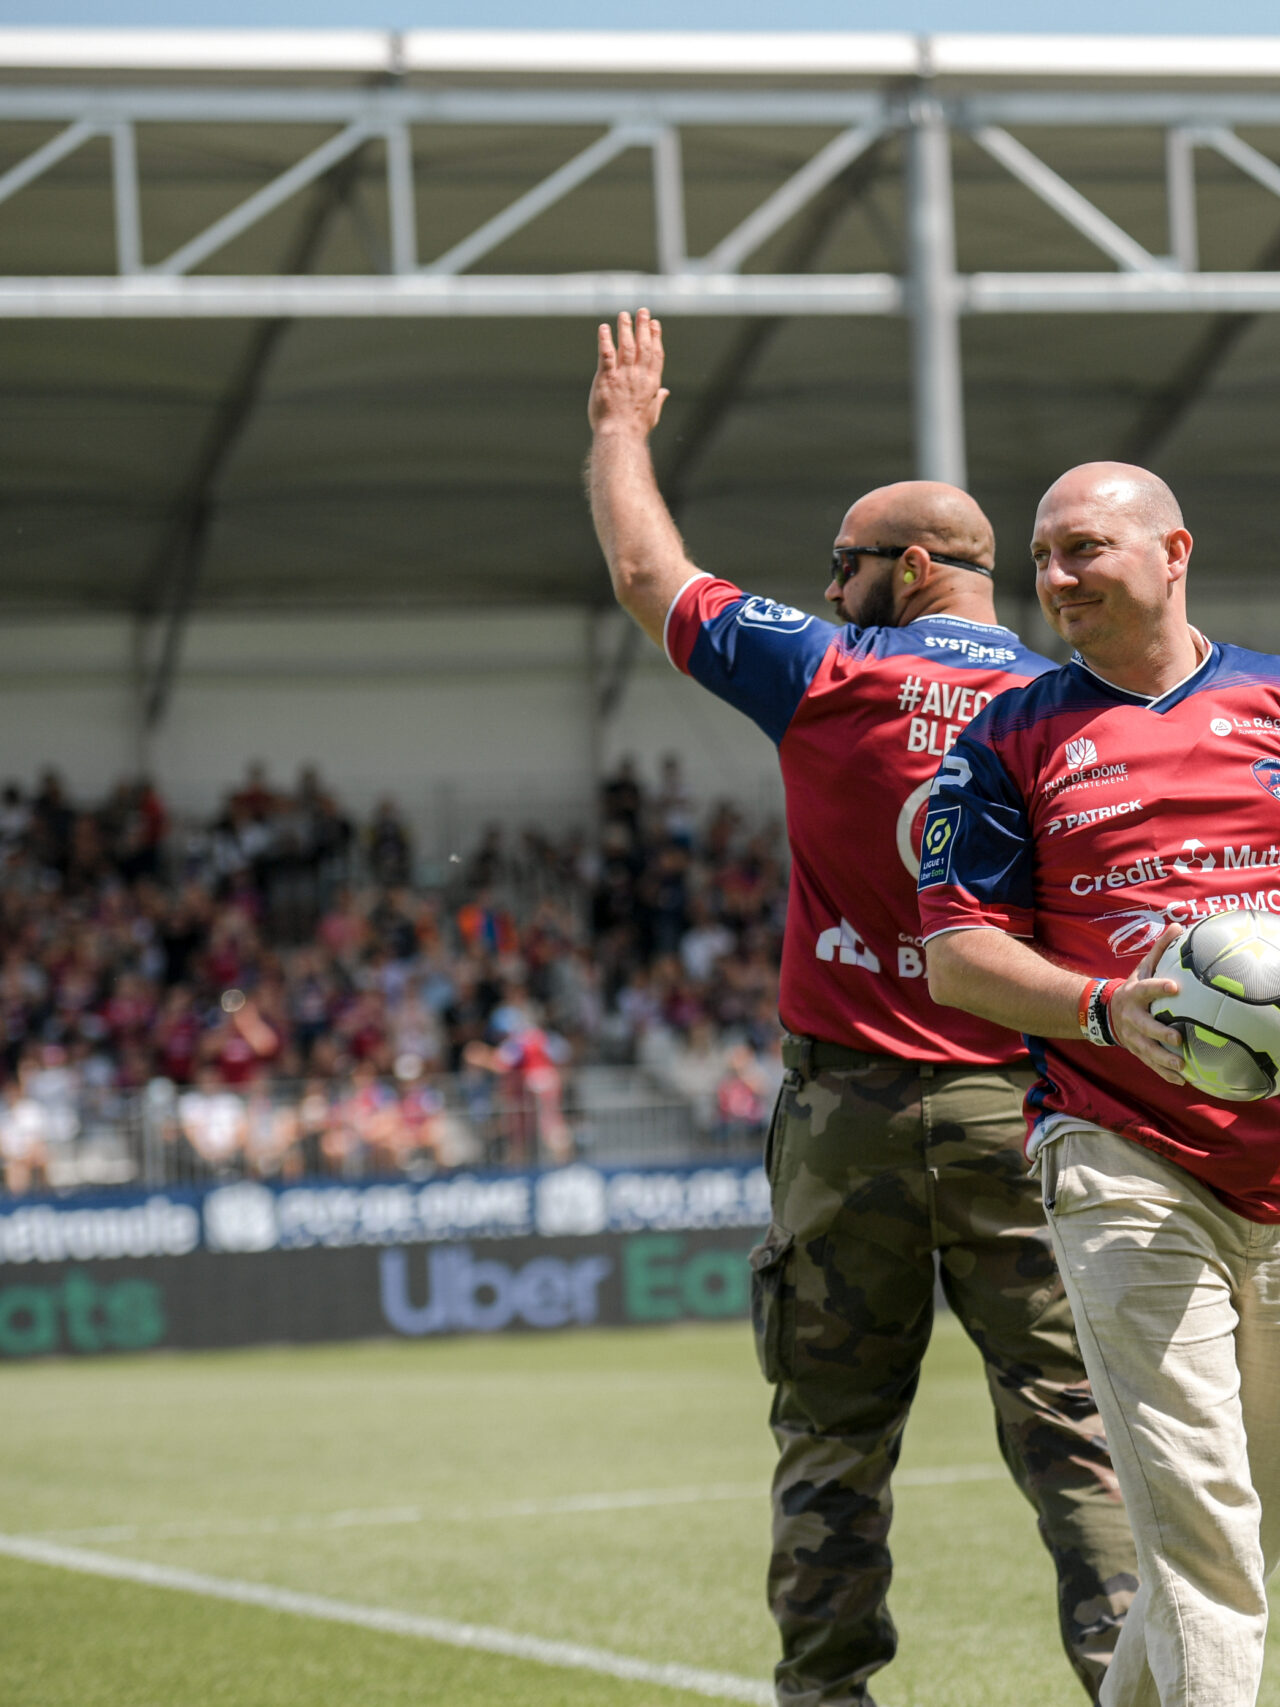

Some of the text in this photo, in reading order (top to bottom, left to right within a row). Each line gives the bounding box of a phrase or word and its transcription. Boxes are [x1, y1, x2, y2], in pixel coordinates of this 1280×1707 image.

[1233, 718, 1251, 728] La
[1044, 763, 1128, 792] PUY-DE-DÔME
[1065, 799, 1144, 829] PATRICK
[923, 859, 941, 870] LIGUE
[1070, 856, 1168, 896] Crédit
[0, 1268, 166, 1356] ats
[378, 1245, 608, 1336] Uber
[622, 1235, 752, 1322] Ea
